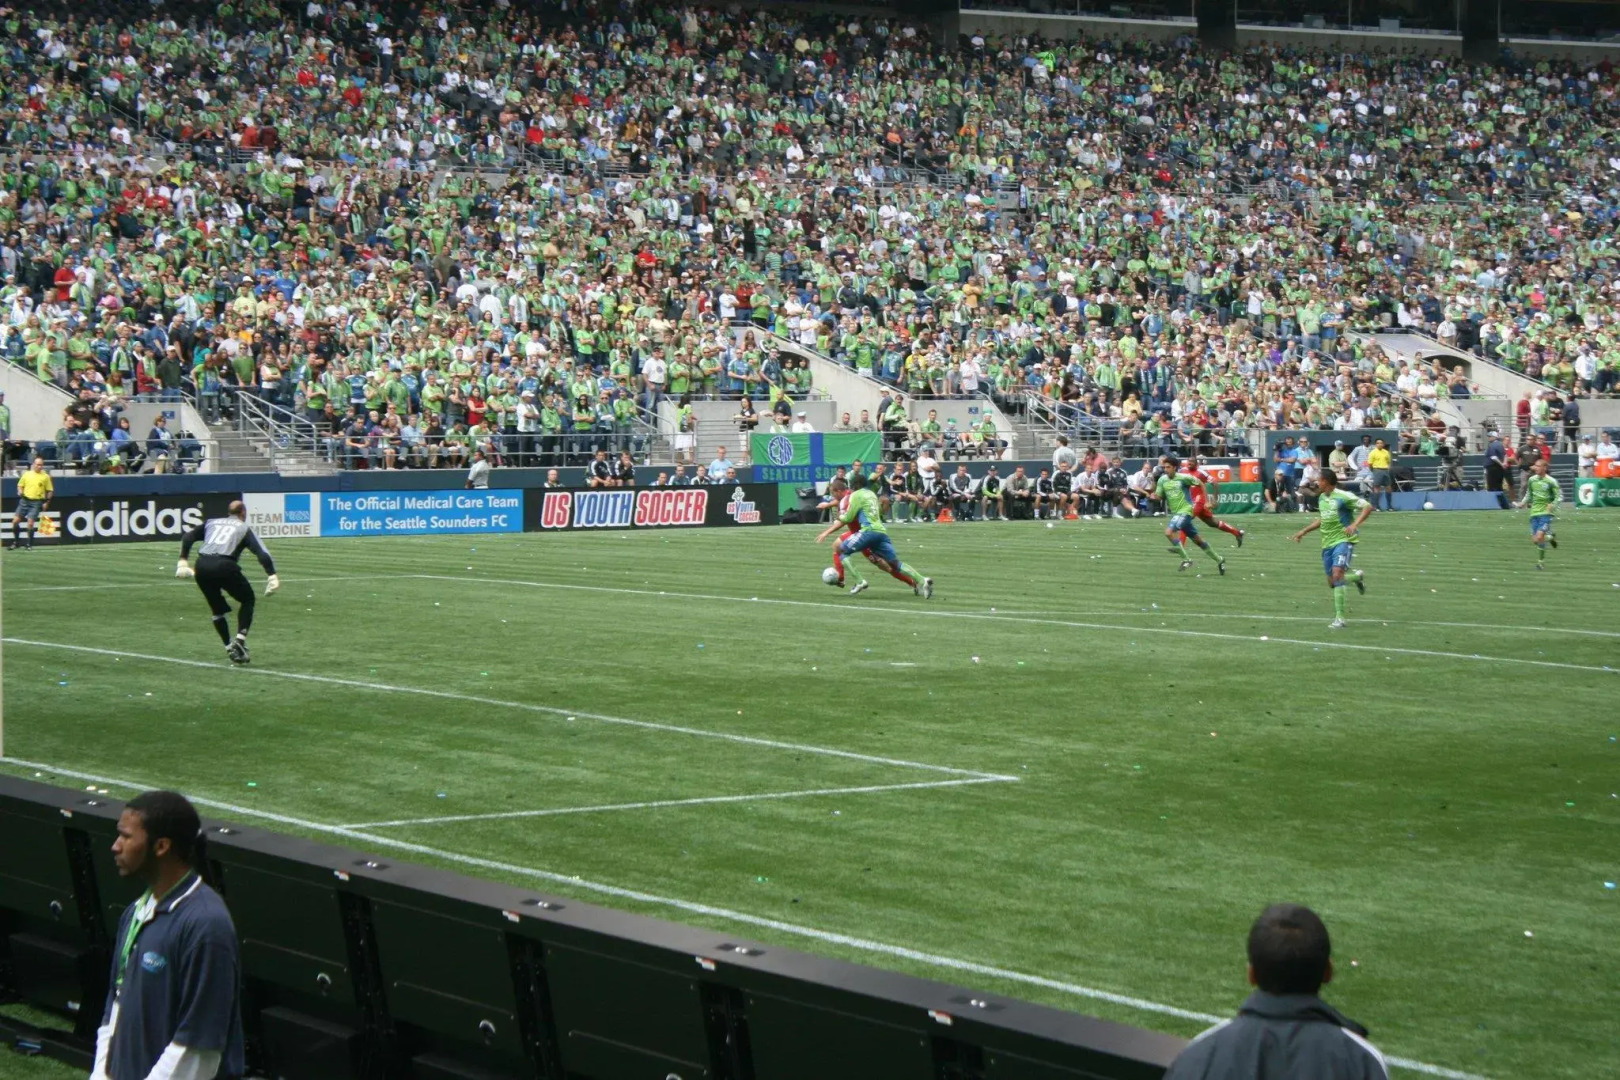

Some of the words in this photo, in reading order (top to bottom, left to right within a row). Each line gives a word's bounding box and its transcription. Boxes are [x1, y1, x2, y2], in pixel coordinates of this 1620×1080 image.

[762, 467, 809, 480] SEATTLE
[1217, 470, 1225, 479] G
[1252, 465, 1259, 474] G
[1251, 492, 1262, 504] G
[1579, 483, 1595, 504] G
[328, 498, 352, 511] The
[355, 496, 400, 510] Official
[404, 495, 453, 509] Medical
[455, 496, 484, 508] Care
[486, 495, 519, 508] Team
[542, 492, 571, 527] US
[574, 491, 634, 526] YOUTH
[635, 490, 707, 525] SOCCER
[67, 500, 203, 537] adidas
[249, 513, 283, 524] TEAM
[339, 516, 358, 530] for
[361, 516, 382, 530] the
[385, 516, 427, 530] Seattle
[430, 514, 487, 528] Sounders
[491, 514, 508, 527] FC
[208, 524, 236, 545] 18
[250, 525, 311, 536] MEDICINE
